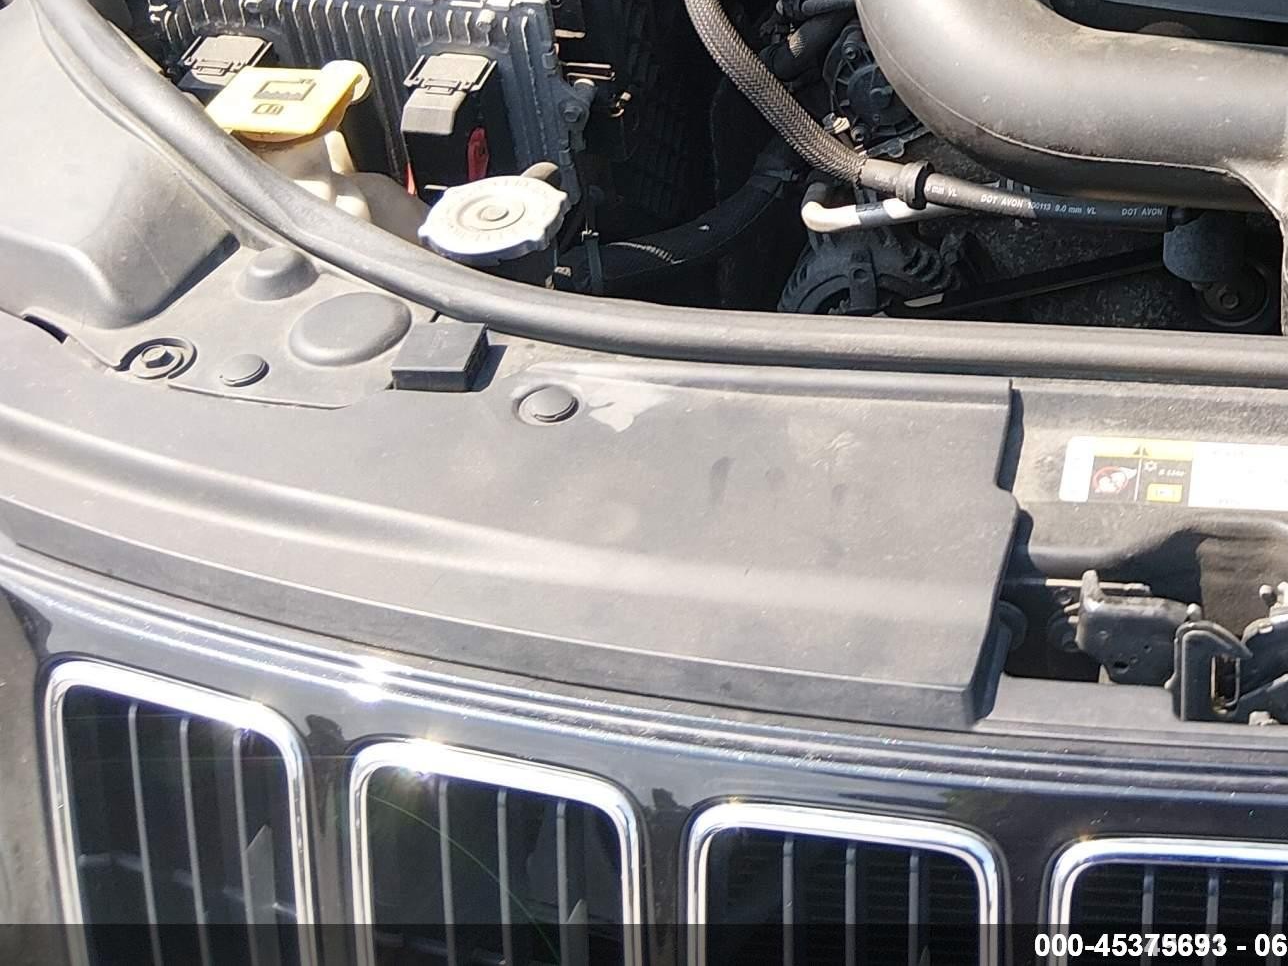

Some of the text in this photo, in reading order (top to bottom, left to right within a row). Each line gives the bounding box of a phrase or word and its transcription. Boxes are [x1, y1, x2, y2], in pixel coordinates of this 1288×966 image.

[980, 193, 997, 205] DOT
[1001, 196, 1024, 208] AVON
[1068, 206, 1082, 214] mm
[1087, 206, 1097, 215] VL
[1121, 208, 1137, 216] DOT
[1141, 208, 1163, 216] AVON
